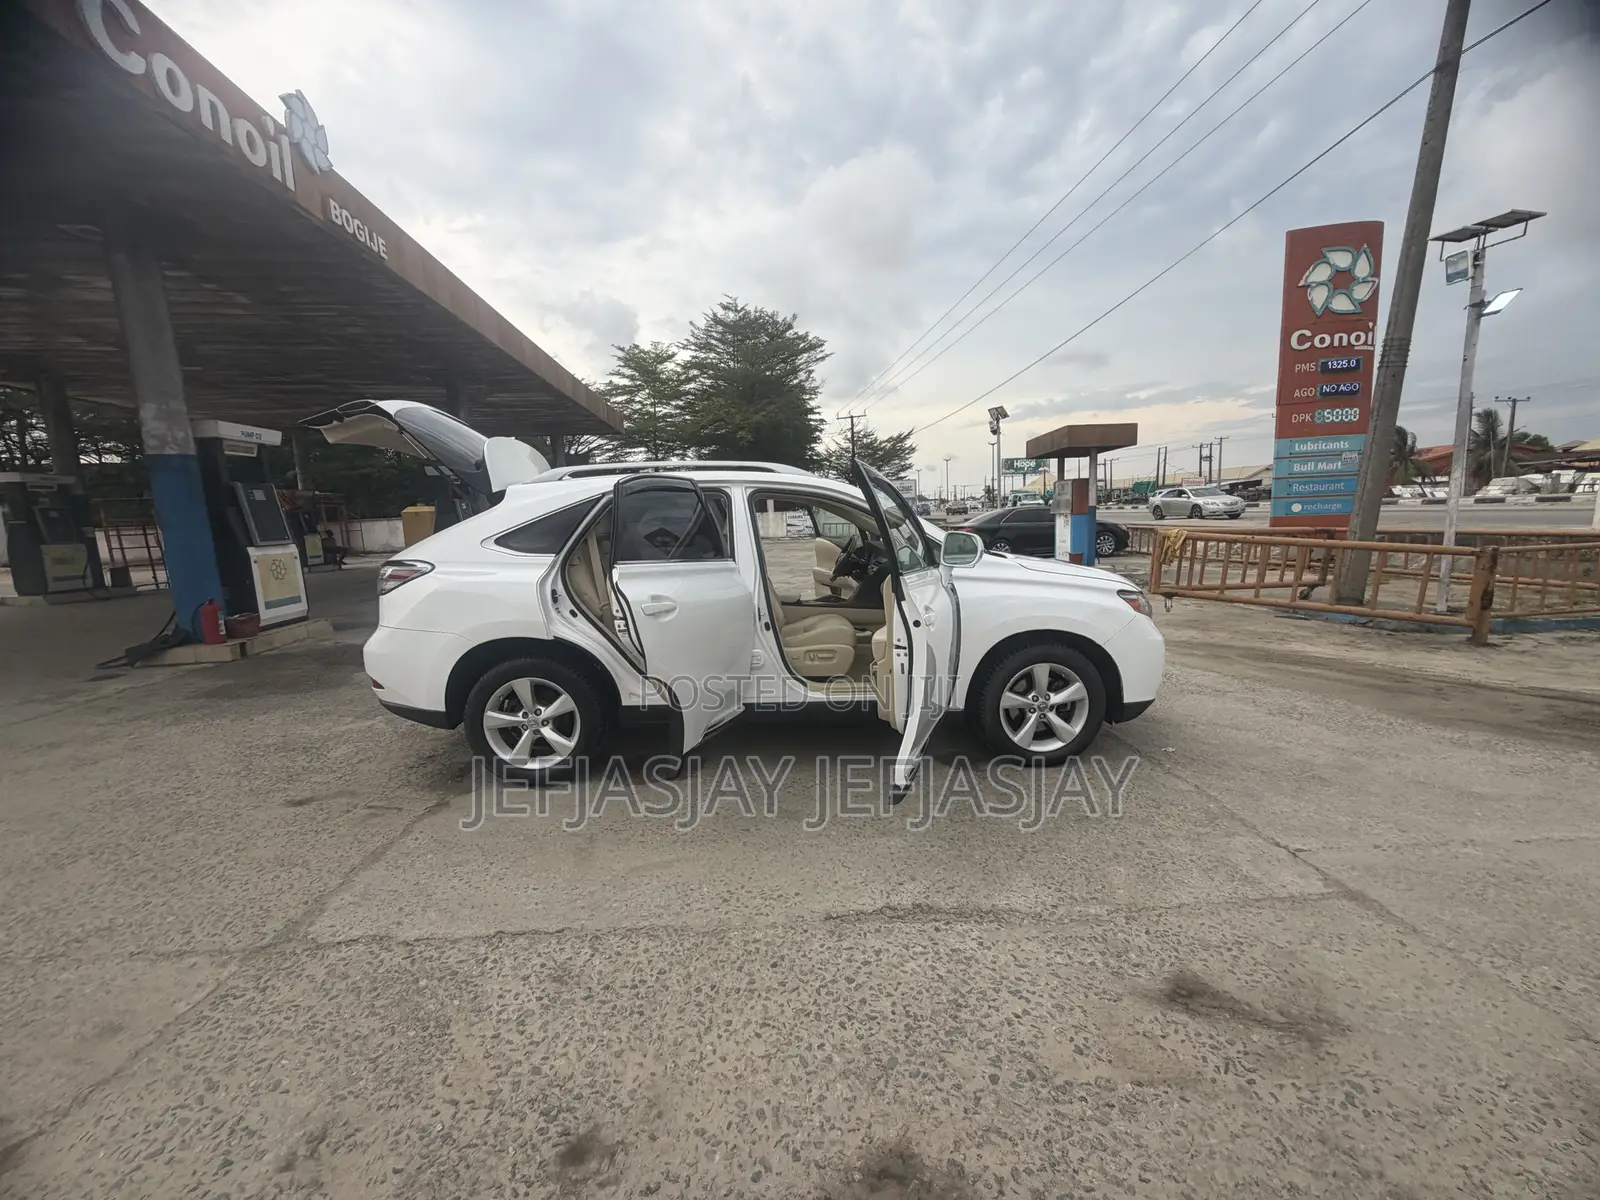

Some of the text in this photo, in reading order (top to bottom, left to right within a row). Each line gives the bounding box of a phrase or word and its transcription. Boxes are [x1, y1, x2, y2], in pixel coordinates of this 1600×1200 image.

[78, 0, 296, 191] Conoil
[328, 198, 388, 260] BOGIJE
[1295, 362, 1316, 373] PMS
[1293, 383, 1359, 398] AGO NO AGO
[1291, 413, 1312, 423] DPK
[1295, 440, 1349, 451] Lubricants
[1013, 459, 1036, 472] Hope
[1293, 461, 1342, 472] Bull Mart
[1292, 482, 1345, 492] Restaurant
[1303, 502, 1342, 511] recharge
